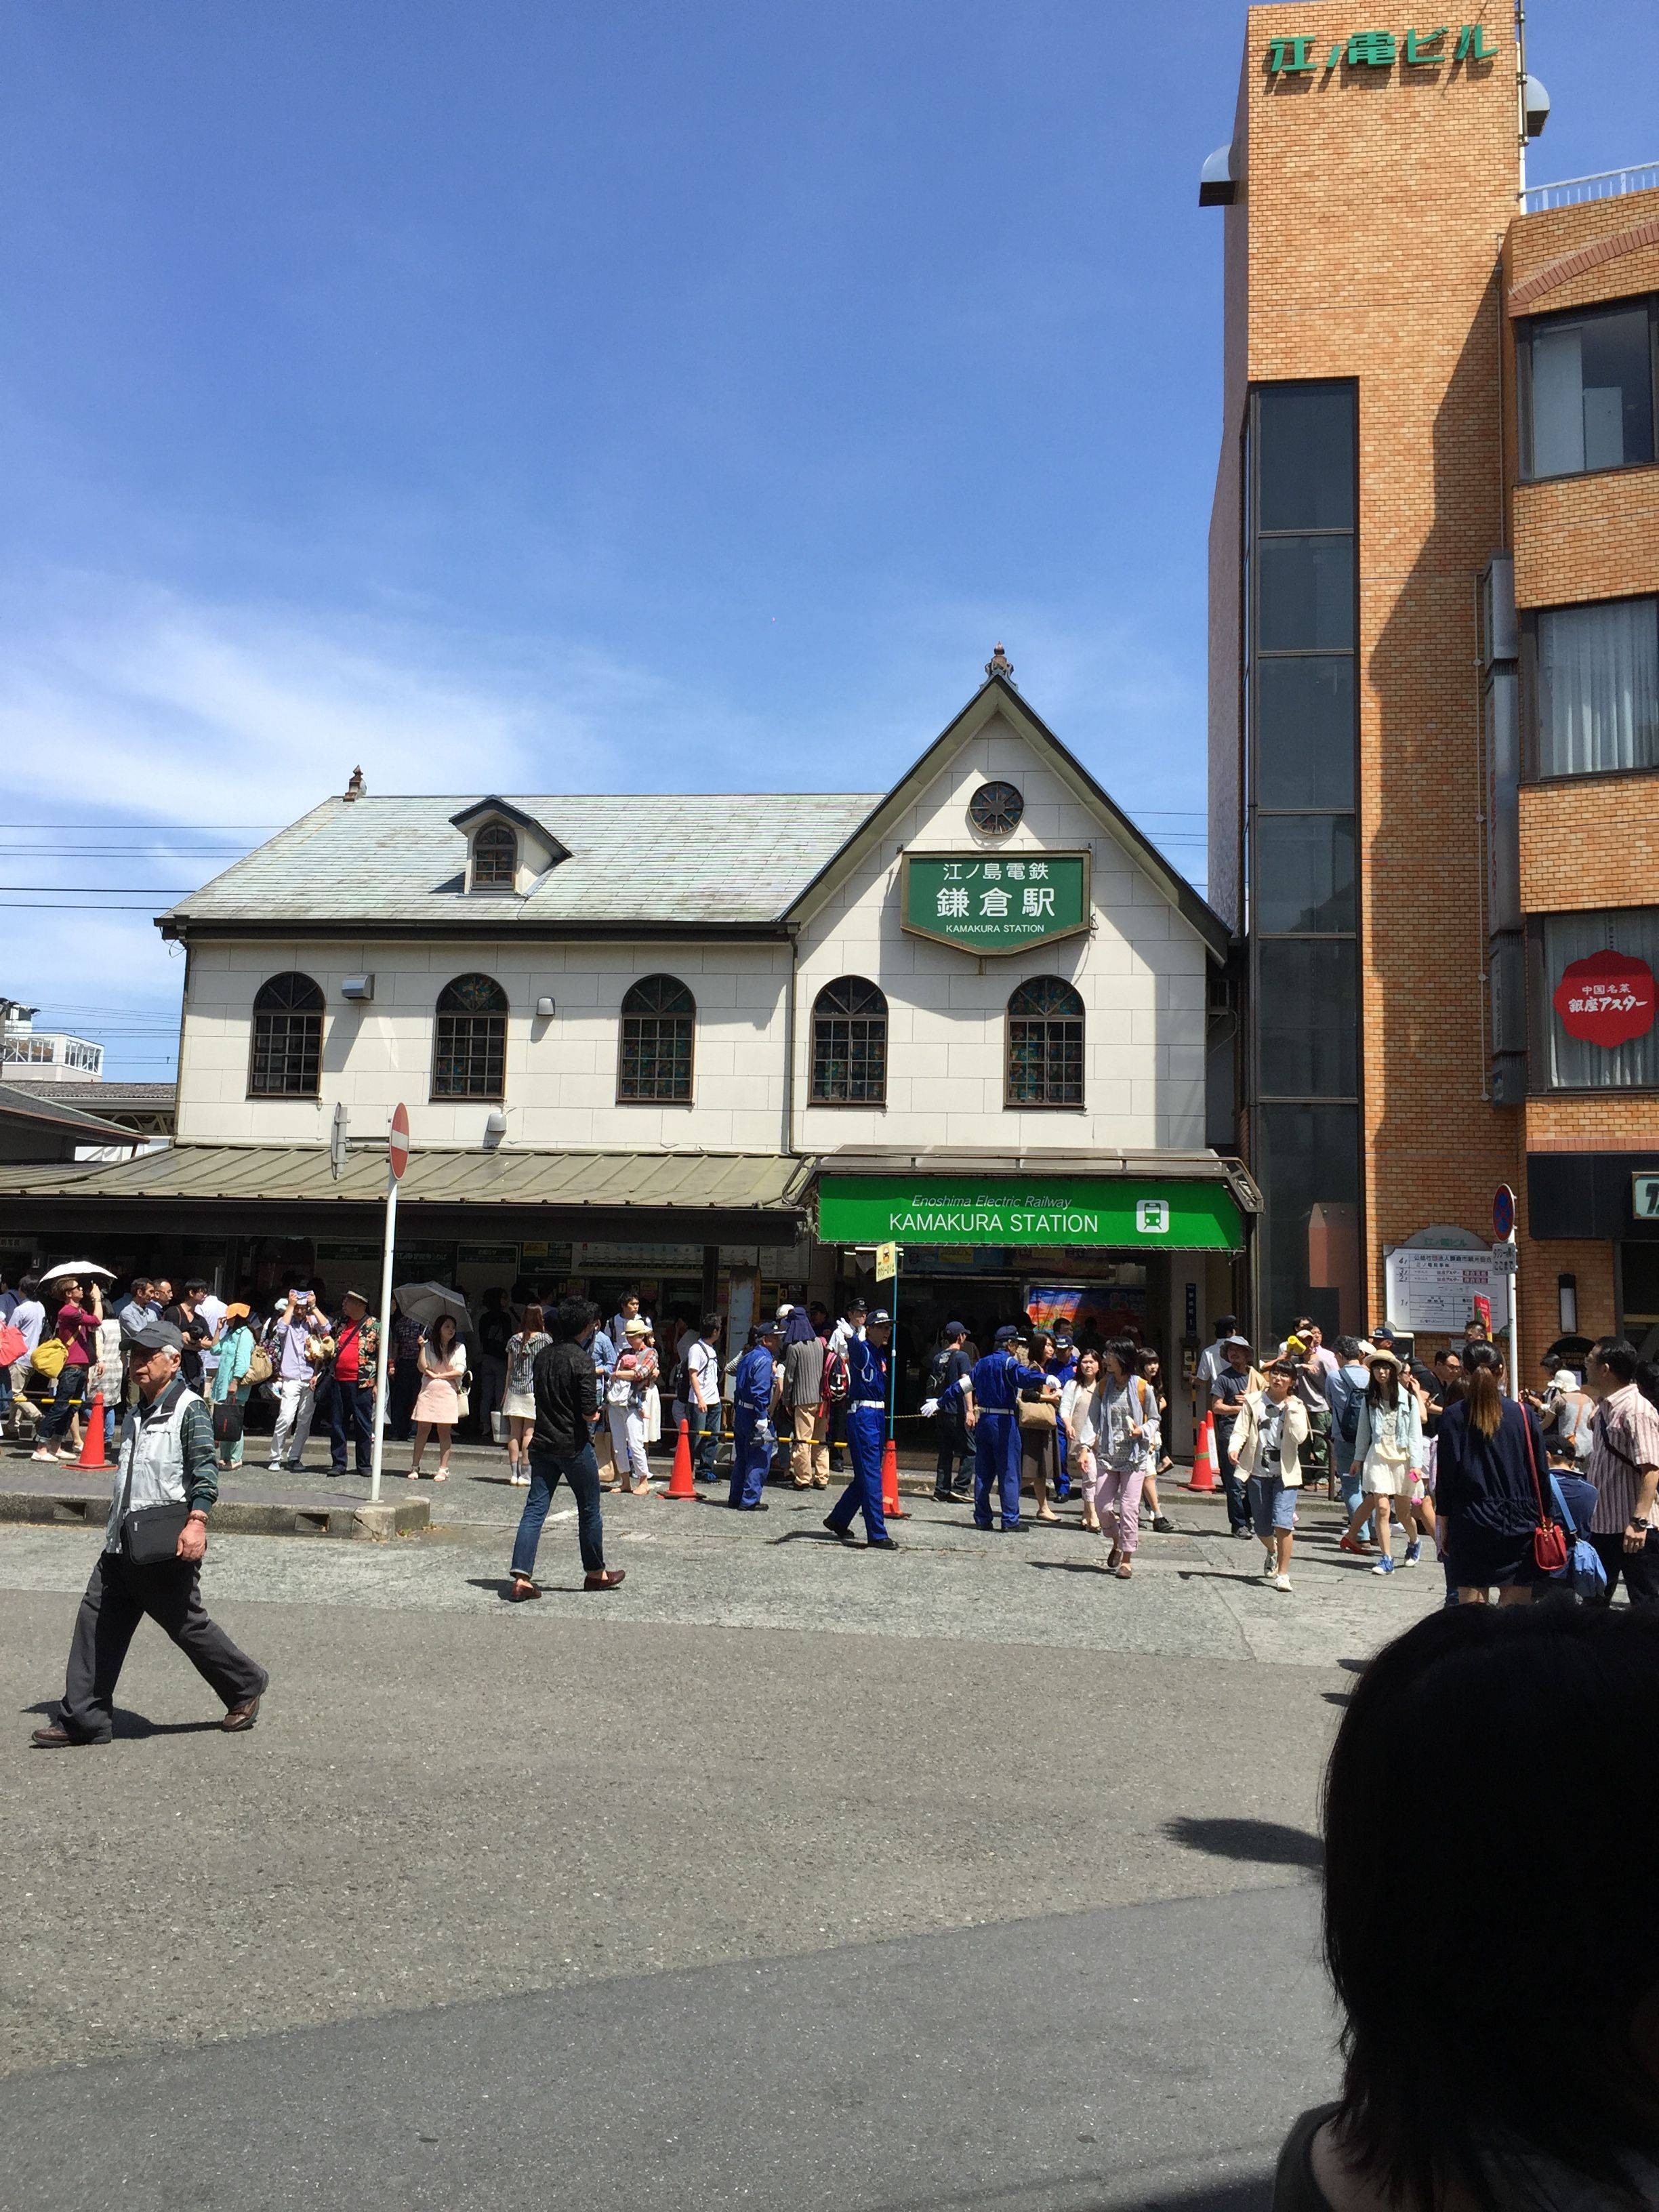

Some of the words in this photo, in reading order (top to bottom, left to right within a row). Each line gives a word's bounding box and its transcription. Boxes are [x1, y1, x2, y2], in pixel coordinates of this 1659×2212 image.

[1270, 24, 1500, 73] 江ノ電ビル
[943, 862, 1049, 880] 江ノ島電鉄
[936, 887, 1055, 918] 鎌倉駅
[946, 924, 1000, 933] KAMAKURA
[1004, 924, 1044, 933] STATION
[1568, 995, 1648, 1012] 銀座アスター
[912, 1195, 971, 1207] Enoshima
[975, 1195, 1021, 1207] Electric
[1025, 1196, 1072, 1210] Railway
[889, 1213, 1003, 1231] KAMAKURA
[1010, 1214, 1098, 1232] STATION
